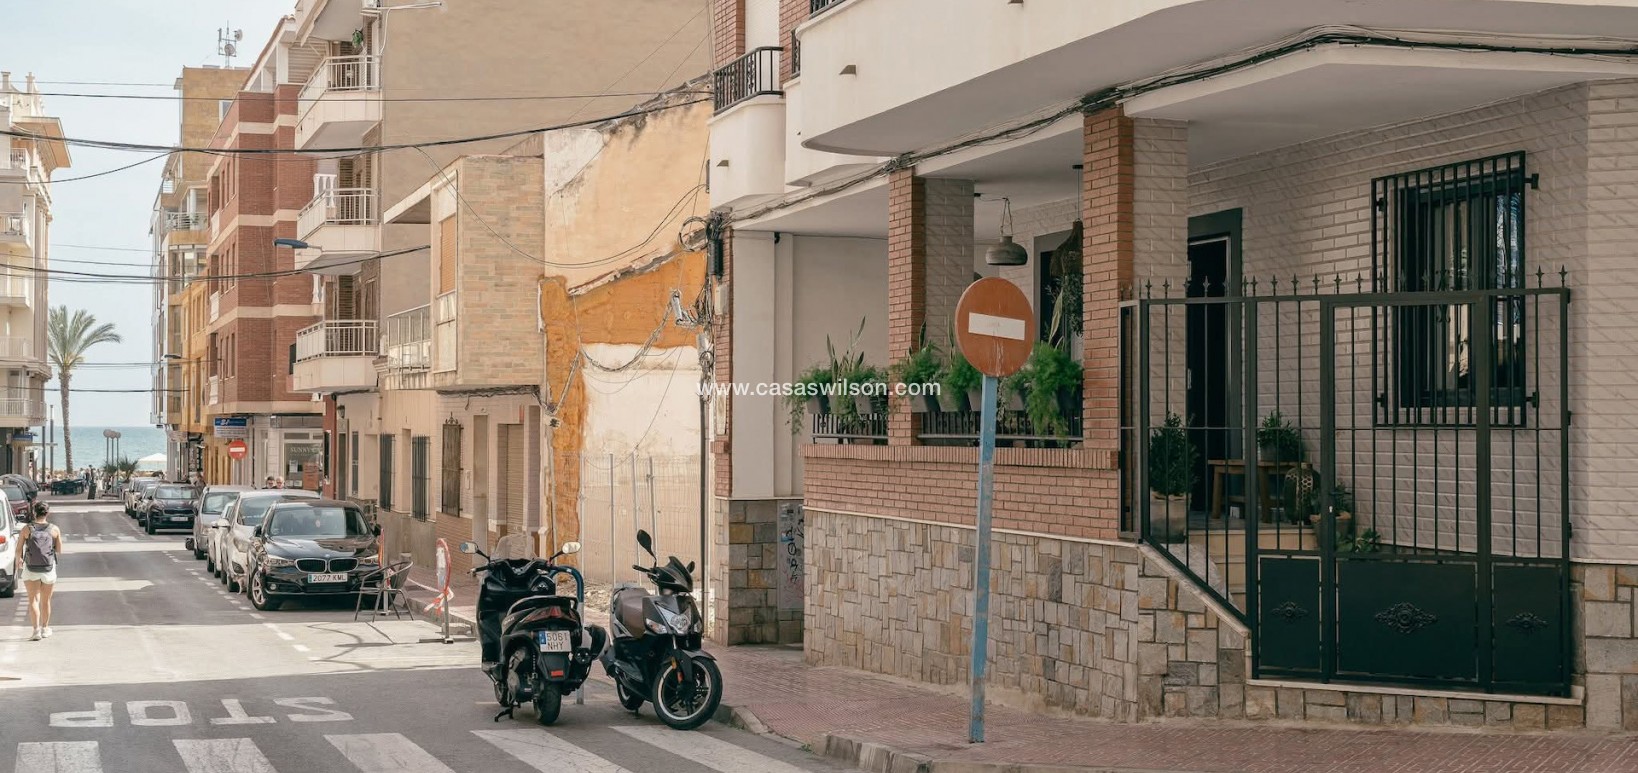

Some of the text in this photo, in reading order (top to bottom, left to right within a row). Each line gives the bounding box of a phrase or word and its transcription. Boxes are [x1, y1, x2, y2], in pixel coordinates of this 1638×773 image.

[313, 574, 331, 582] 2077
[546, 632, 568, 641] 5061
[547, 642, 564, 650] NHY
[48, 696, 355, 728] STOP
